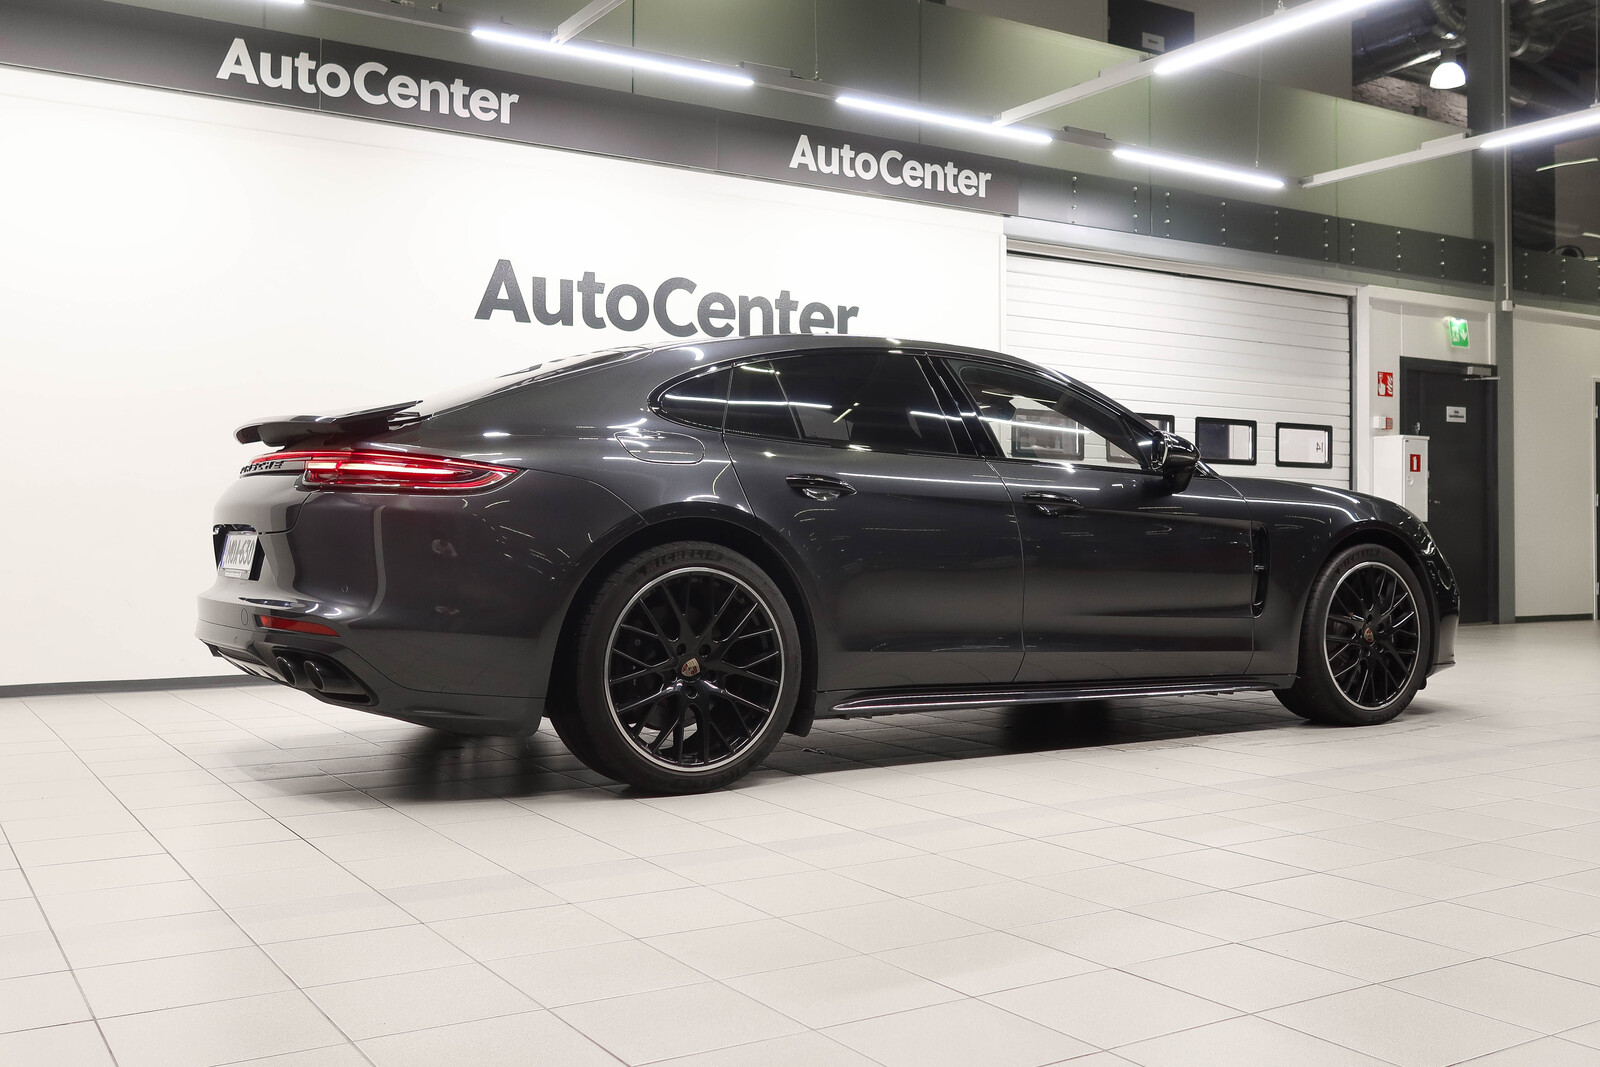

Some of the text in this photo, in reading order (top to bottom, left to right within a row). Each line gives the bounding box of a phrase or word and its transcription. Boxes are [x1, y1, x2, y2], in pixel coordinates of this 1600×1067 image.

[216, 38, 520, 125] AutoCenter
[789, 135, 992, 198] AutoCenter
[475, 260, 860, 338] AutoCenter
